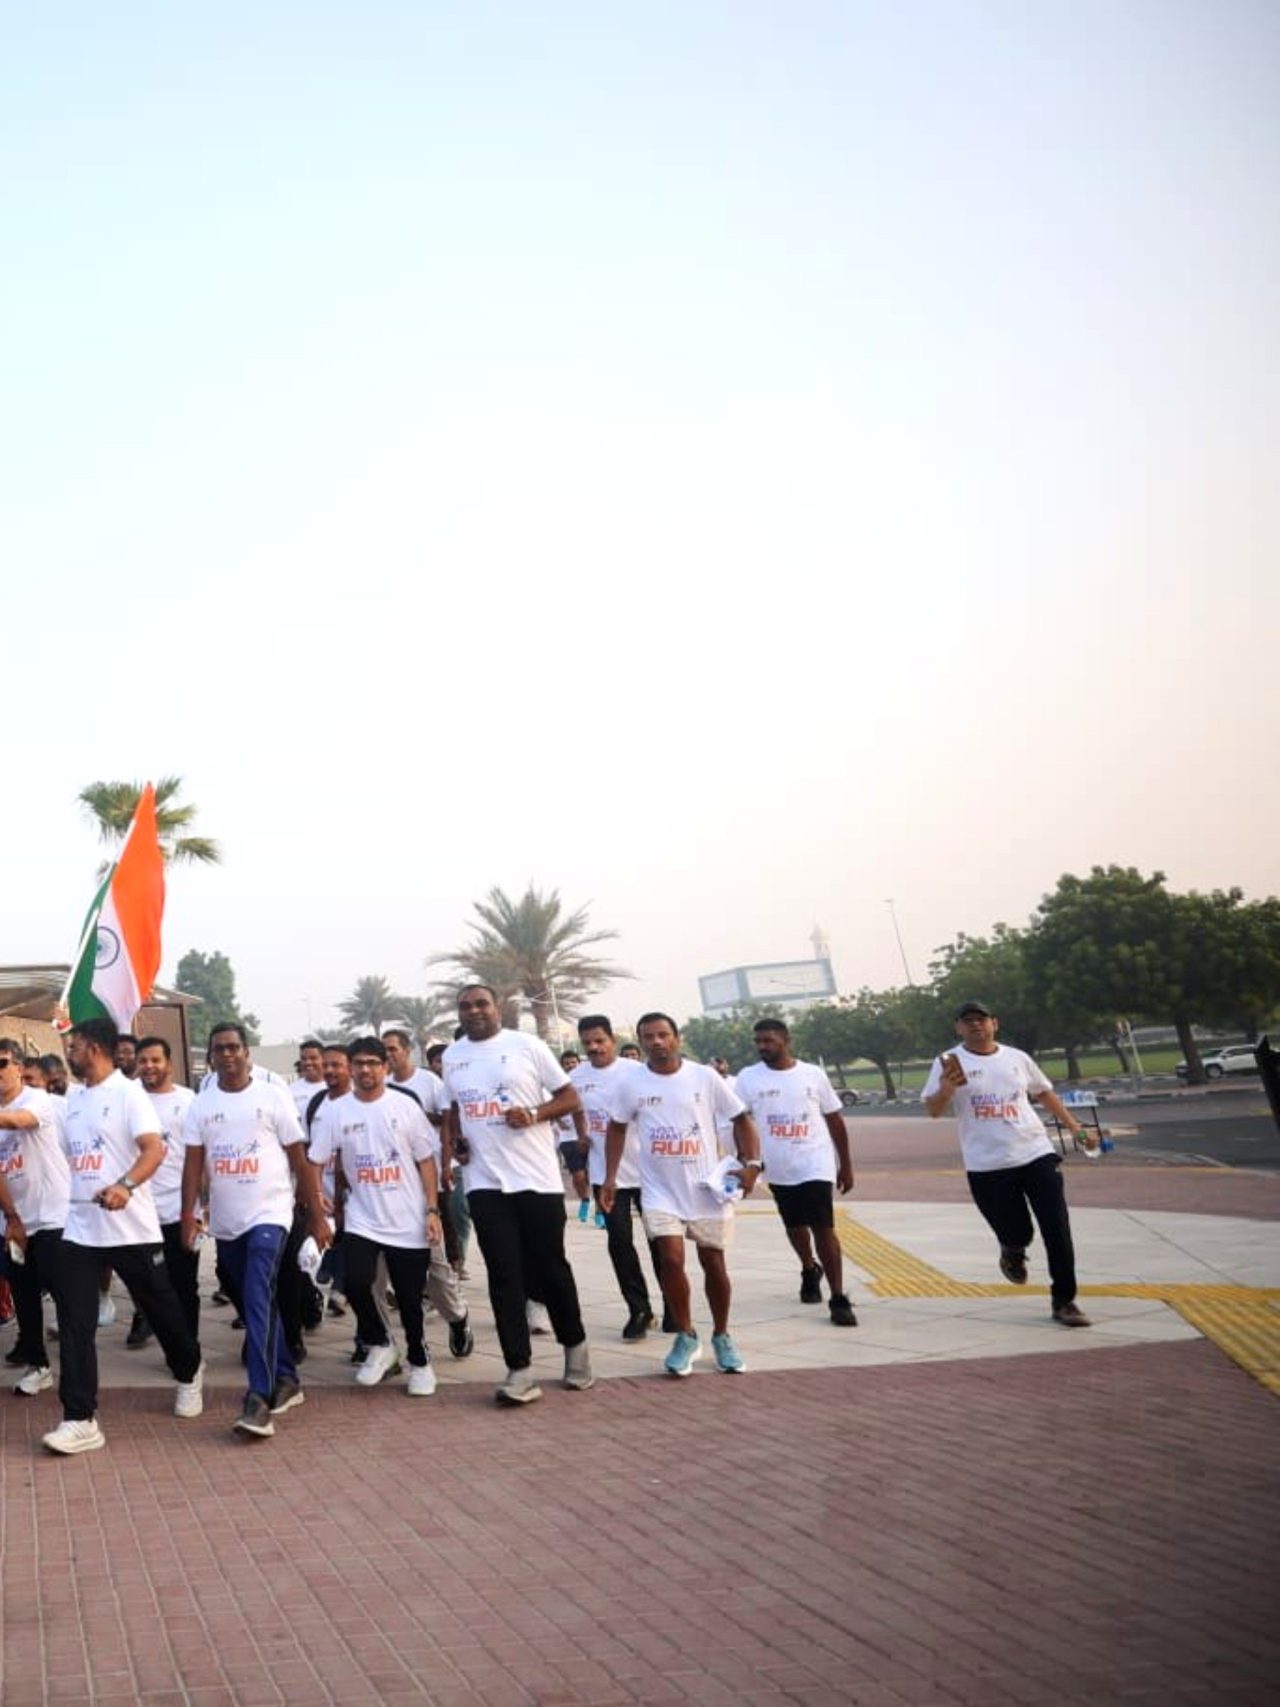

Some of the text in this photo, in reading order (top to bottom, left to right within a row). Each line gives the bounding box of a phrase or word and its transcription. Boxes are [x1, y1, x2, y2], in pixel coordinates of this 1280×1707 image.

[770, 1125, 808, 1137] RUN
[651, 1141, 700, 1155] RUN
[214, 1158, 259, 1174] RUN
[357, 1166, 400, 1183] RUN
